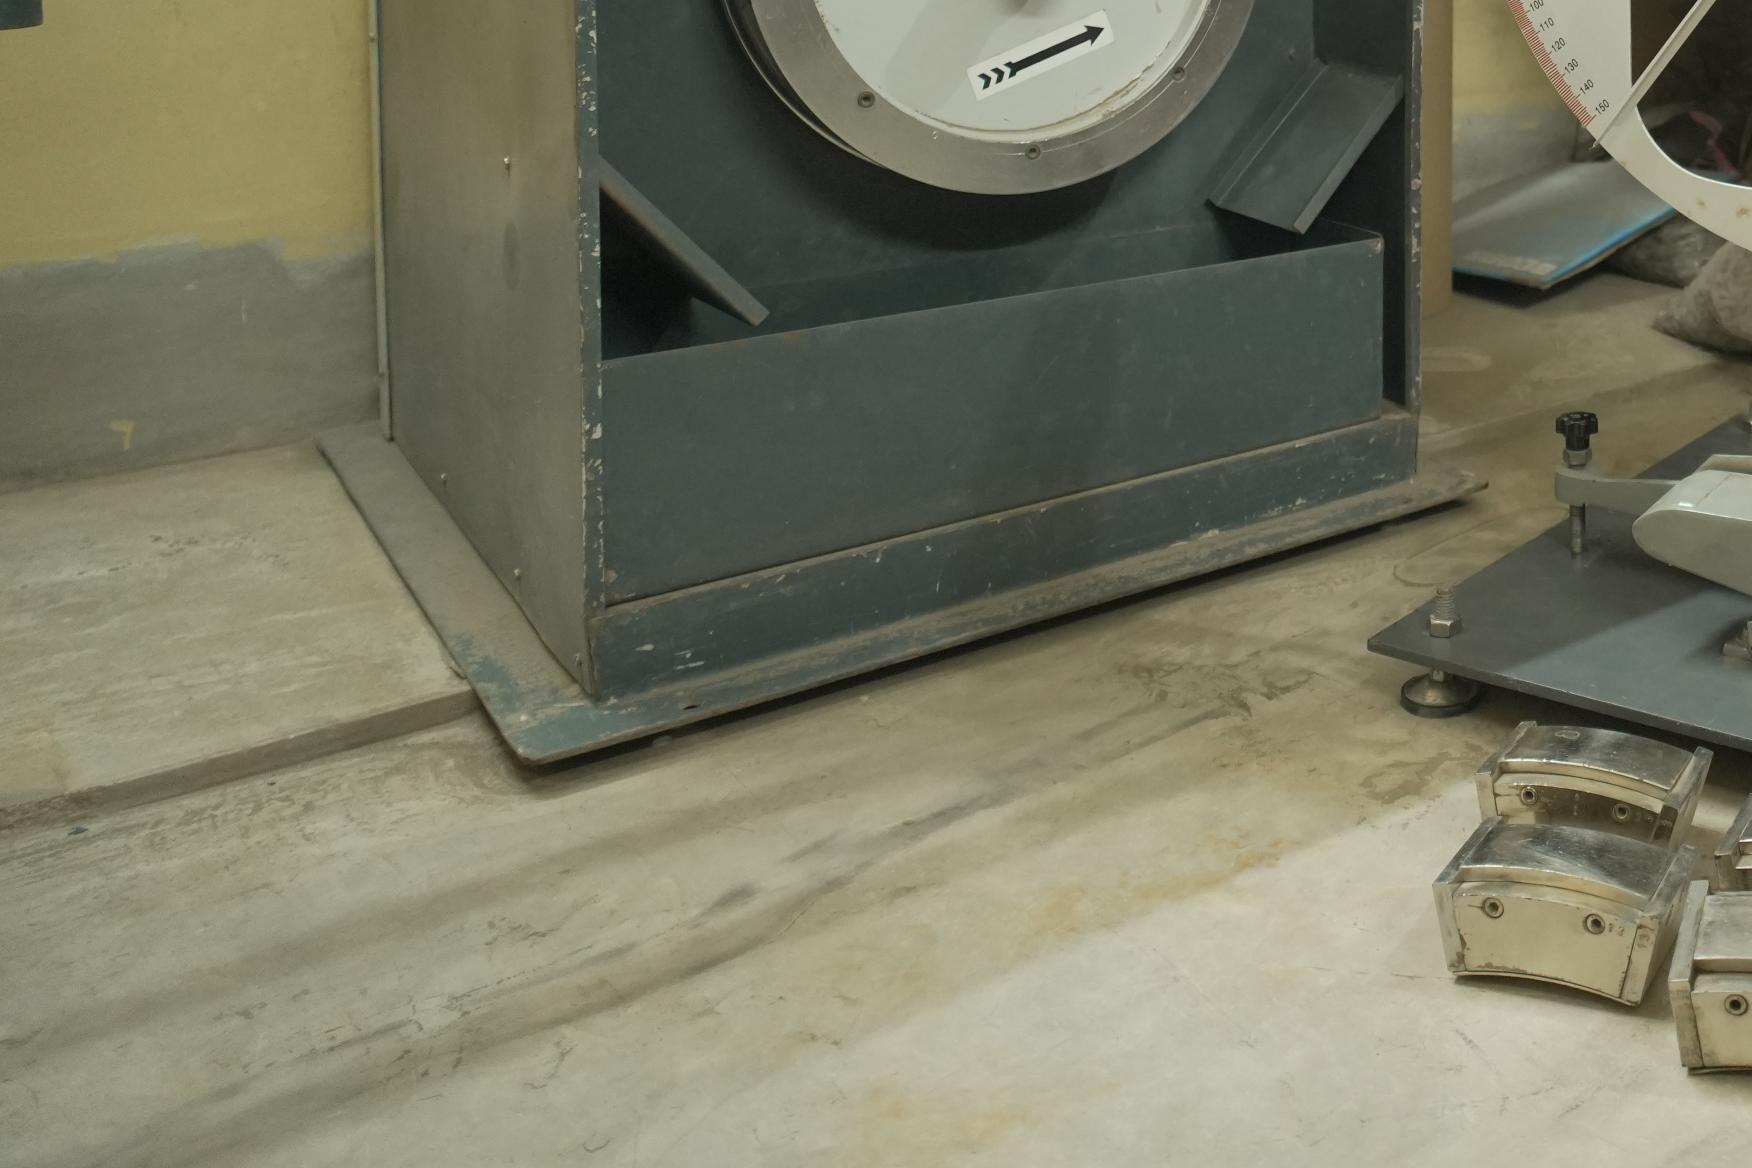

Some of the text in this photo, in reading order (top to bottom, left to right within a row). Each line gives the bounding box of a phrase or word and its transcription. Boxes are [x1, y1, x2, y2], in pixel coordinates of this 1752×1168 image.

[1539, 17, 1555, 32] 110
[1551, 37, 1566, 53] 120
[1564, 58, 1579, 74] 130
[1579, 79, 1594, 95] 140
[1595, 99, 1610, 115] 150
